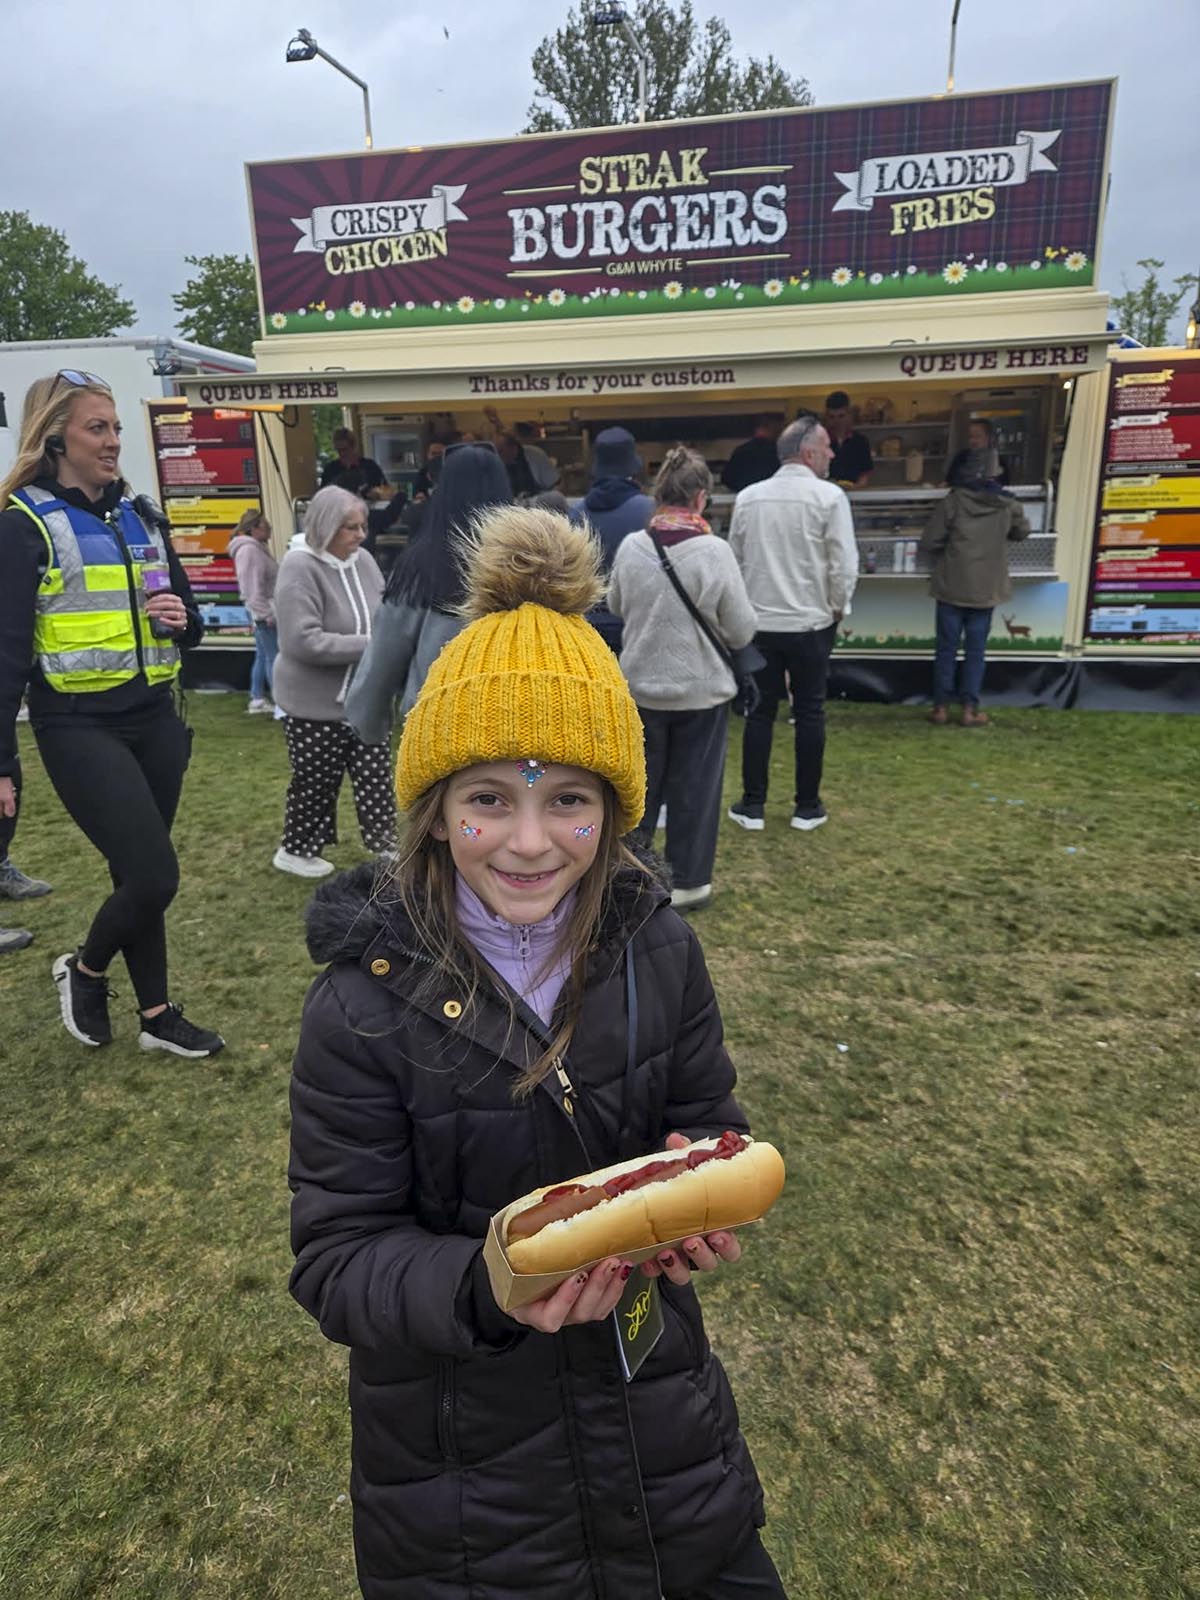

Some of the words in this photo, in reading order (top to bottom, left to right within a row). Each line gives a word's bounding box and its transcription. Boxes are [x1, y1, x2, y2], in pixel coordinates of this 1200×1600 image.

[580, 147, 709, 195] STEAK
[875, 152, 1015, 193] LOADED
[331, 203, 428, 237] CRISPY
[507, 184, 788, 262] BURGERS
[890, 185, 996, 236] FRIES
[324, 228, 448, 276] CHICKEN
[636, 257, 683, 274] WHYTE
[900, 350, 998, 377] QUEUE
[1005, 345, 1089, 368] HERE
[200, 383, 273, 404] QUEUE
[278, 381, 339, 399] HERE
[469, 373, 550, 394] Thanks
[556, 371, 588, 390] for
[592, 370, 646, 394] your
[651, 367, 736, 387] custom
